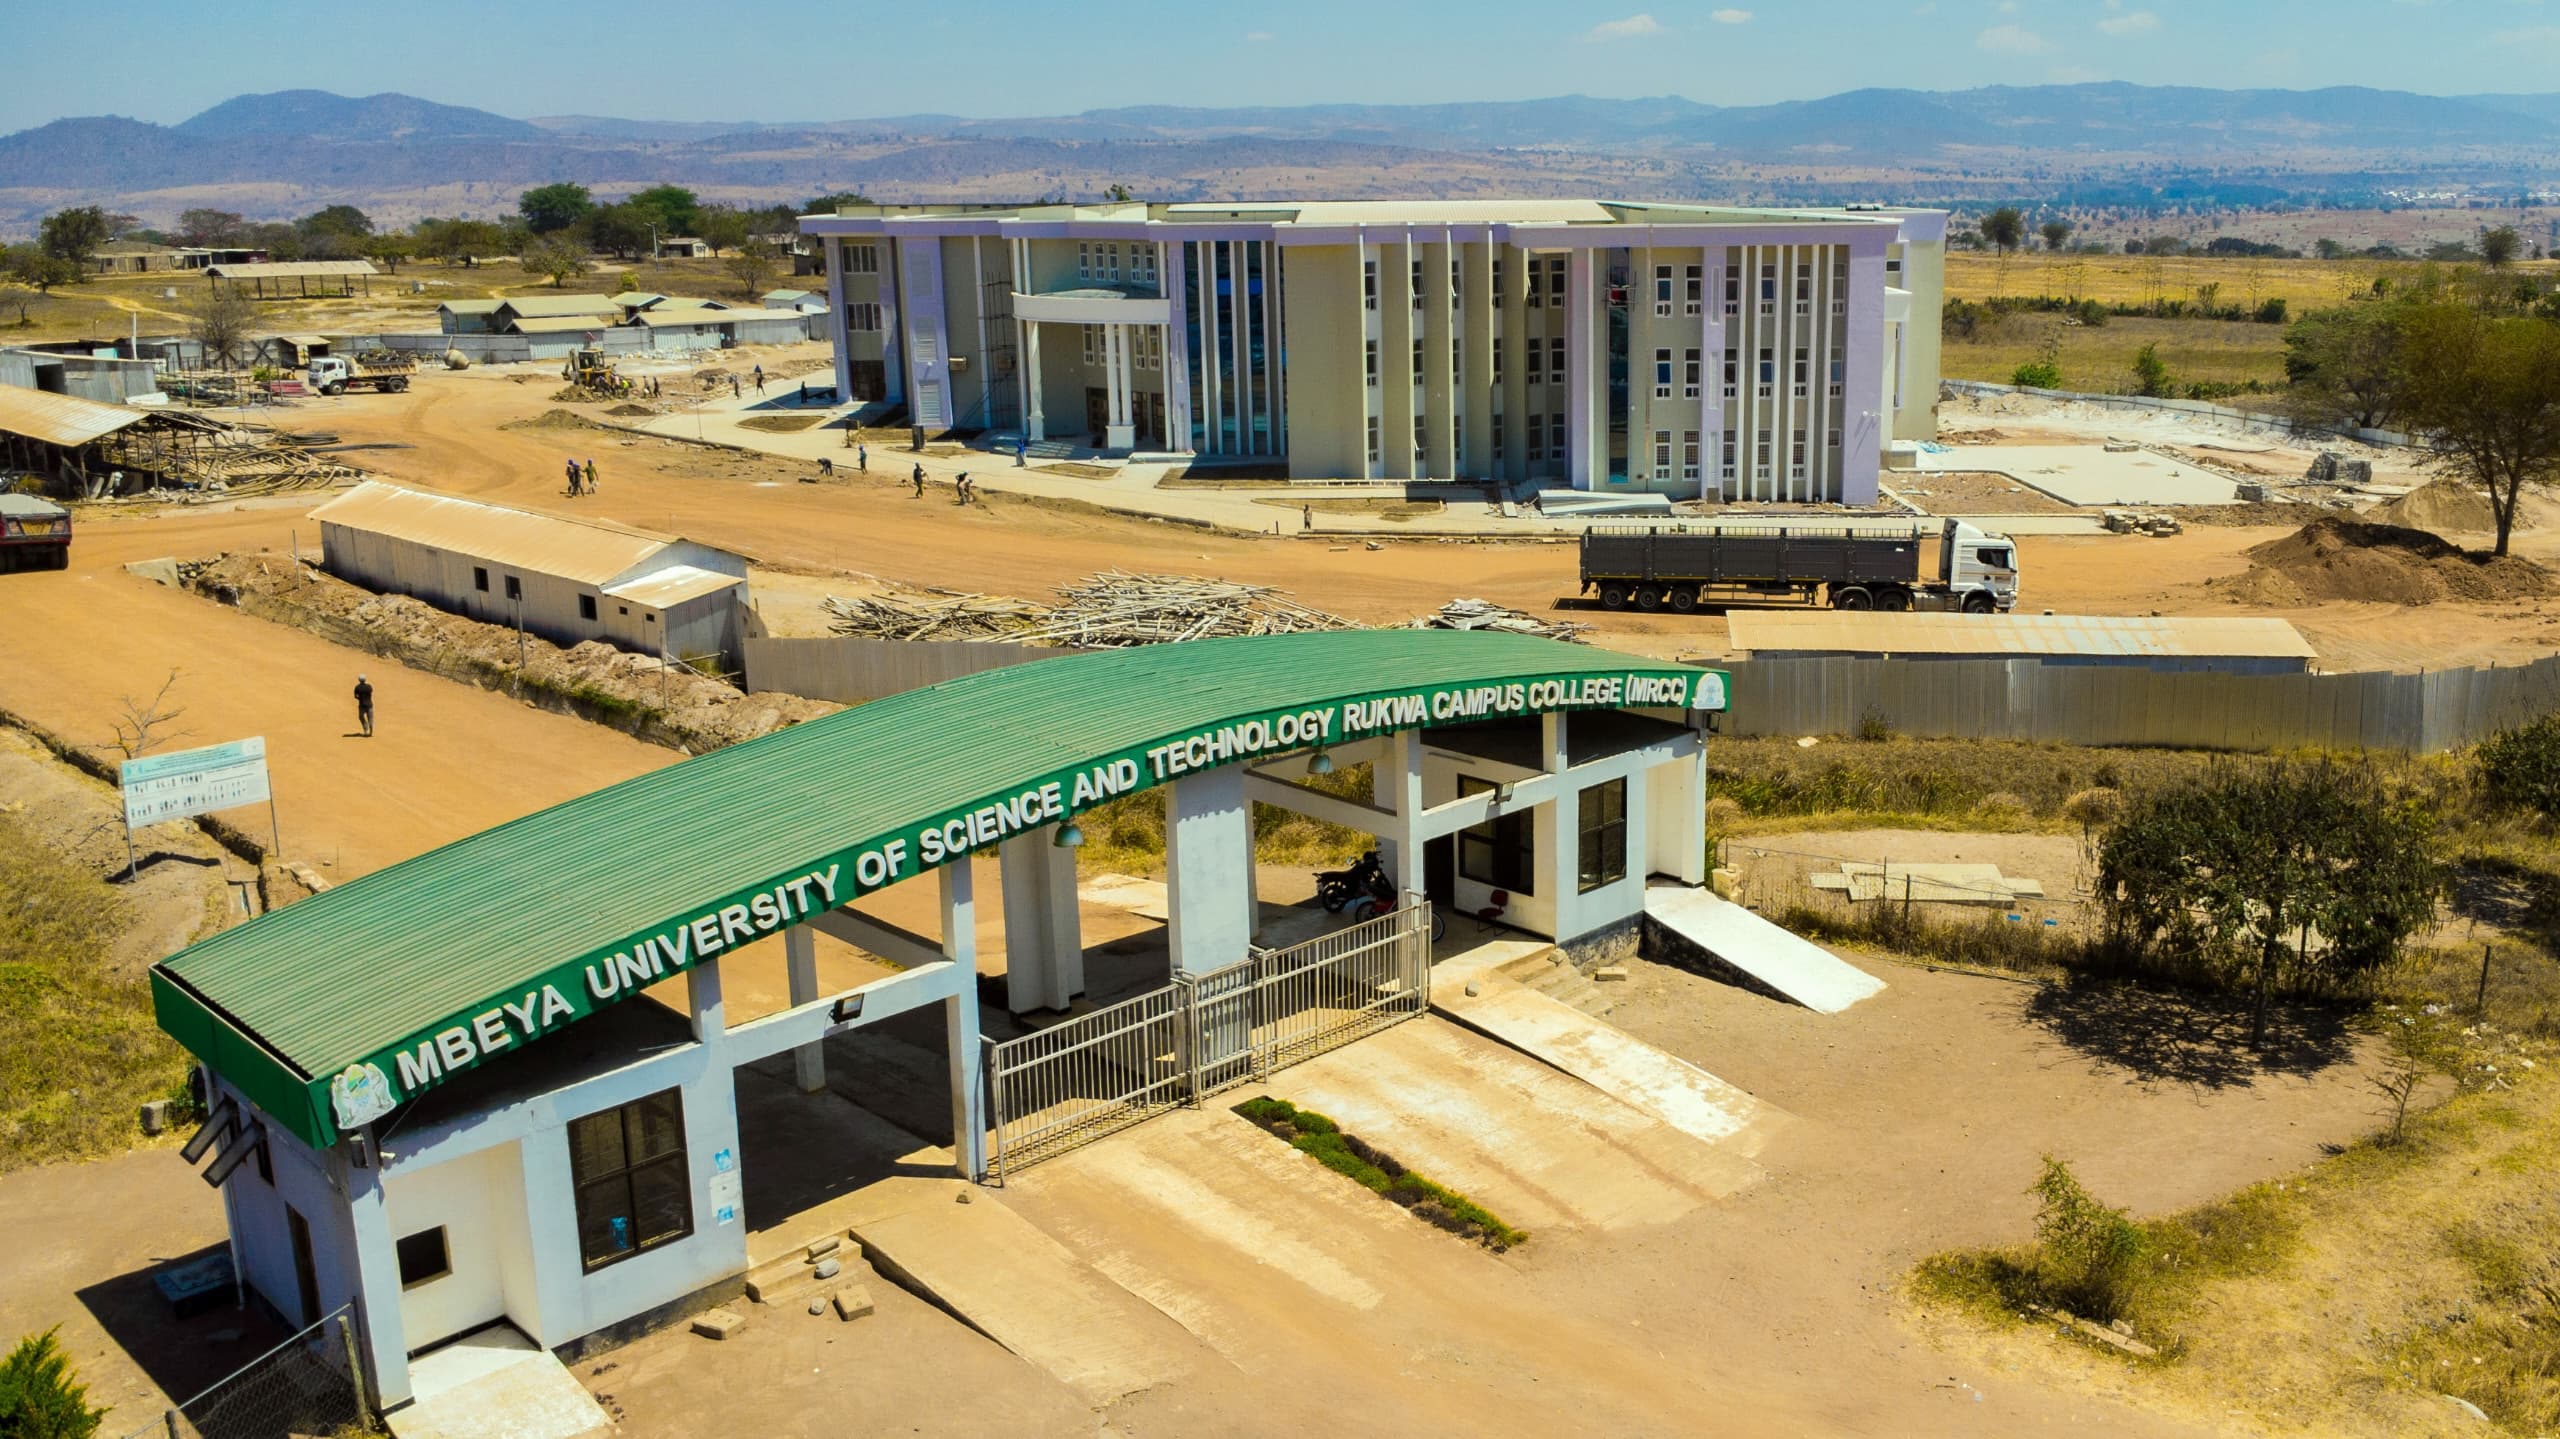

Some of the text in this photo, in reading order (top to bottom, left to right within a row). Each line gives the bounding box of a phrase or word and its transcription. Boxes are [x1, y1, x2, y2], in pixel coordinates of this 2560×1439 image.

[396, 674, 1688, 1091] MBEYA UNIVERSITY OF SCIENCE AND TECHNOLOGY RUKWA CAMPUS COLLEGE (MRCC)
